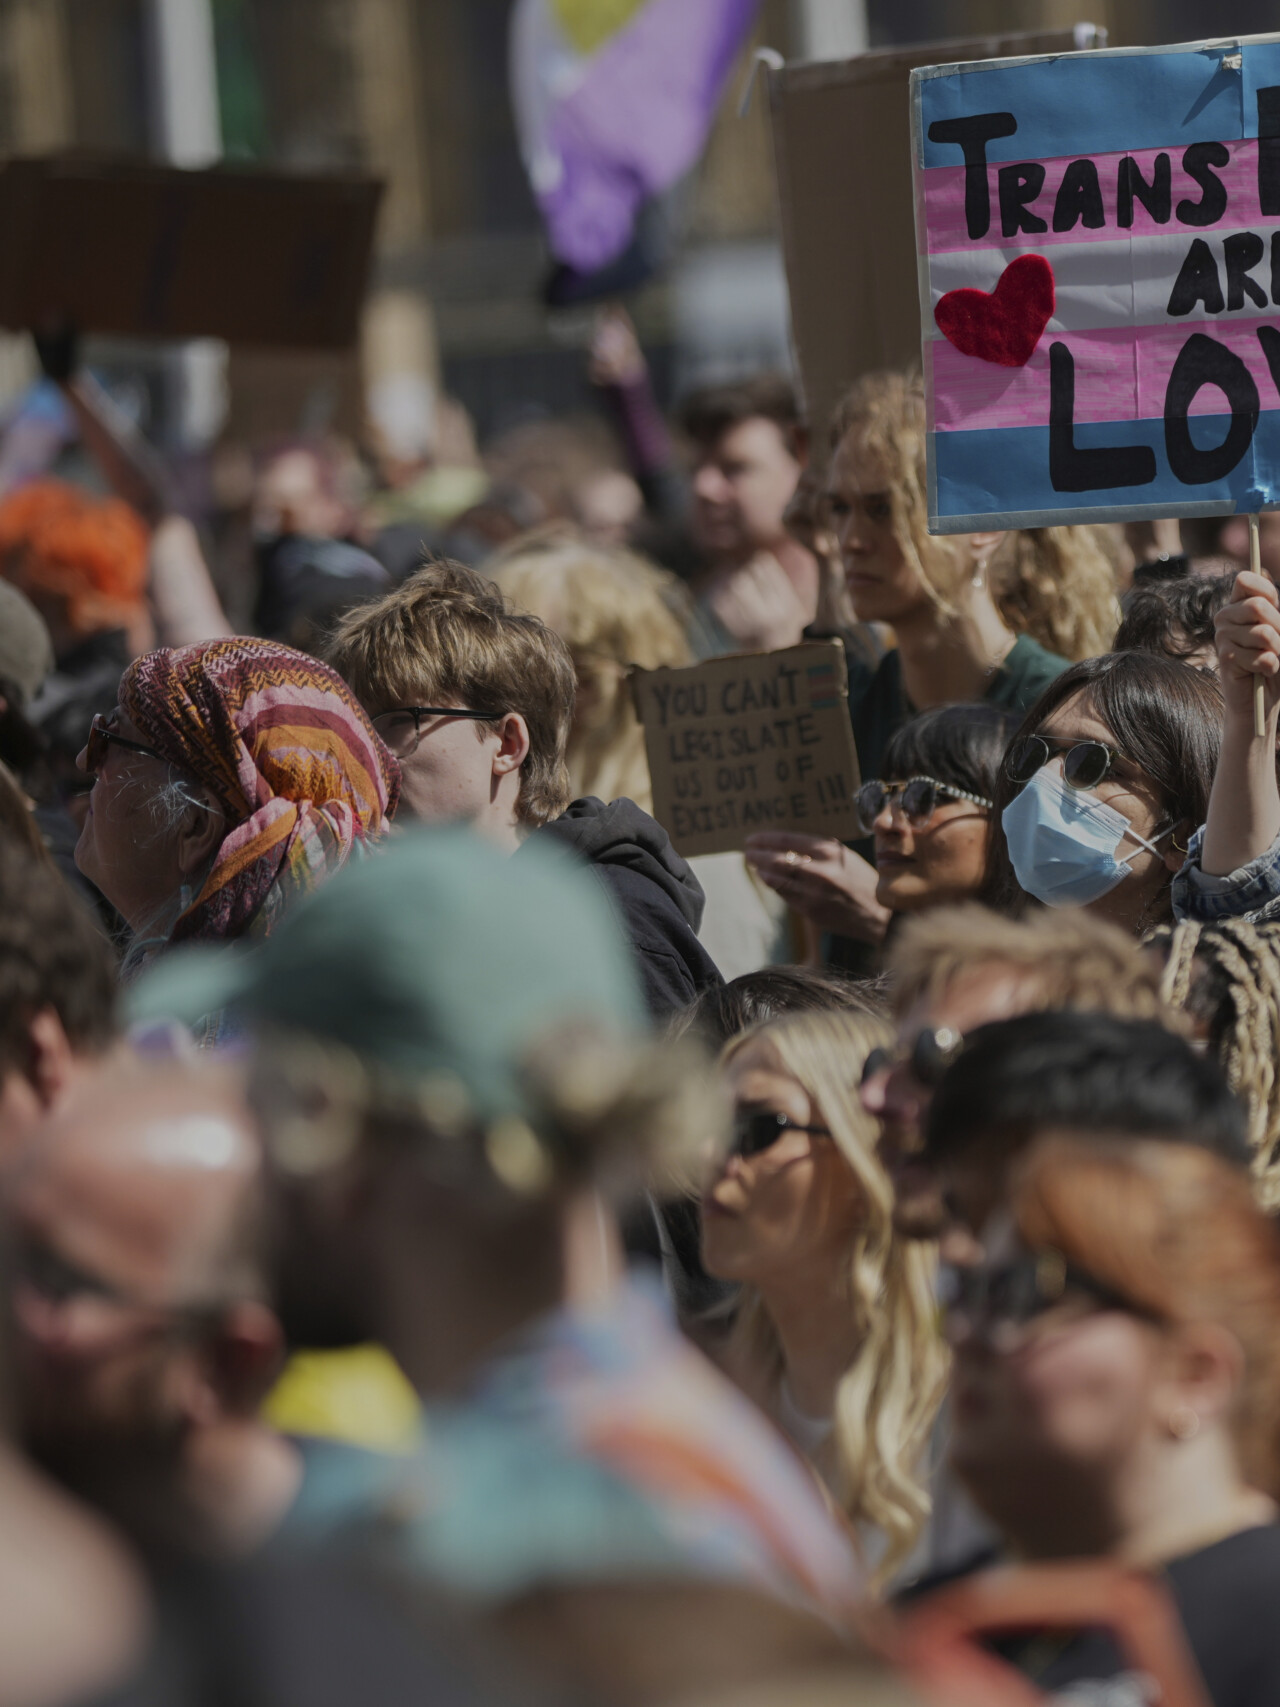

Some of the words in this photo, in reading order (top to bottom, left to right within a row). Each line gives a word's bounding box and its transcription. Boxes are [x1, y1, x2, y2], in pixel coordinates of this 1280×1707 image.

[928, 111, 1231, 241] TRANS
[652, 682, 707, 727] YOU
[668, 713, 822, 763] LEGISLATE
[673, 769, 702, 798] US
[715, 765, 758, 792] OUT
[776, 754, 814, 782] OF
